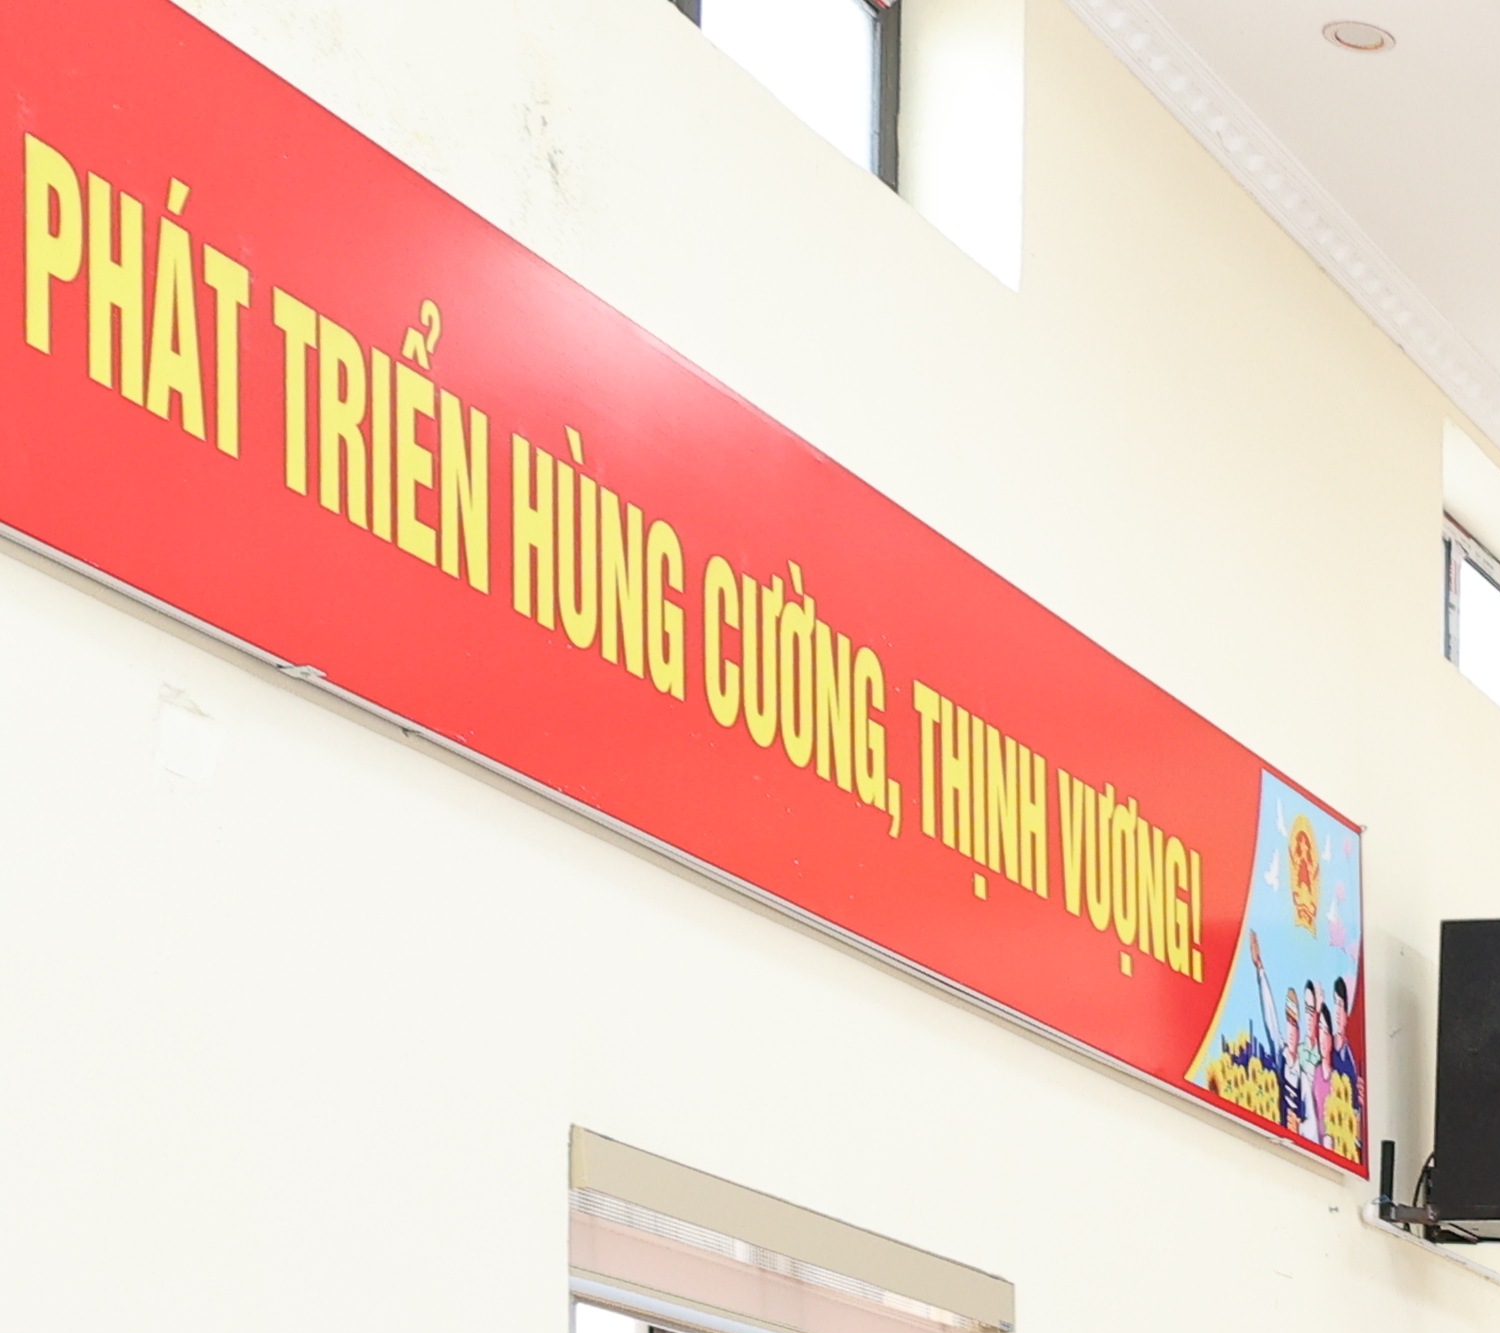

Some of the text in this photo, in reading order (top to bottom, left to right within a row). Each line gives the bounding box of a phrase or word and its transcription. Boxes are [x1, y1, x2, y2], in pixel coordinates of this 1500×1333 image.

[24, 133, 1203, 983] PHÁT TRIỂN HÙNG CƯỜNG, THỊNH VƯỢNG!
